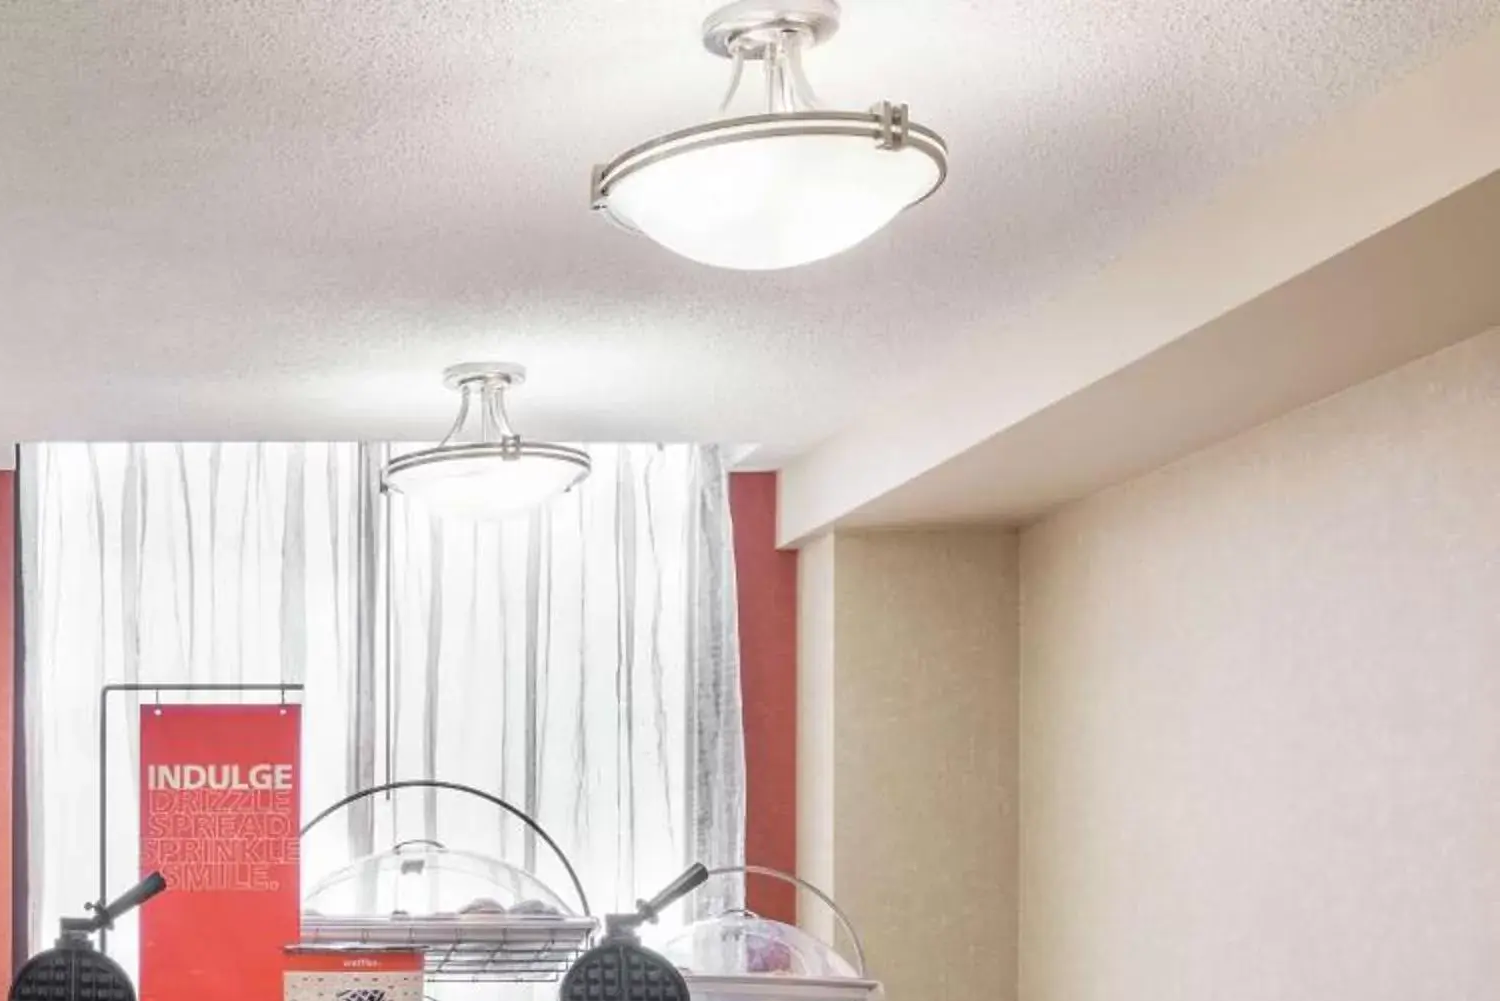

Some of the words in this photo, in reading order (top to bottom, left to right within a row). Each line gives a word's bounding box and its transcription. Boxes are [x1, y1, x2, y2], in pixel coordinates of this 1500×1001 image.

[148, 764, 293, 790] INDULGE
[149, 789, 292, 814] DRIZZLE
[148, 813, 292, 838] SPREAD
[141, 837, 301, 864] SPRINKLE
